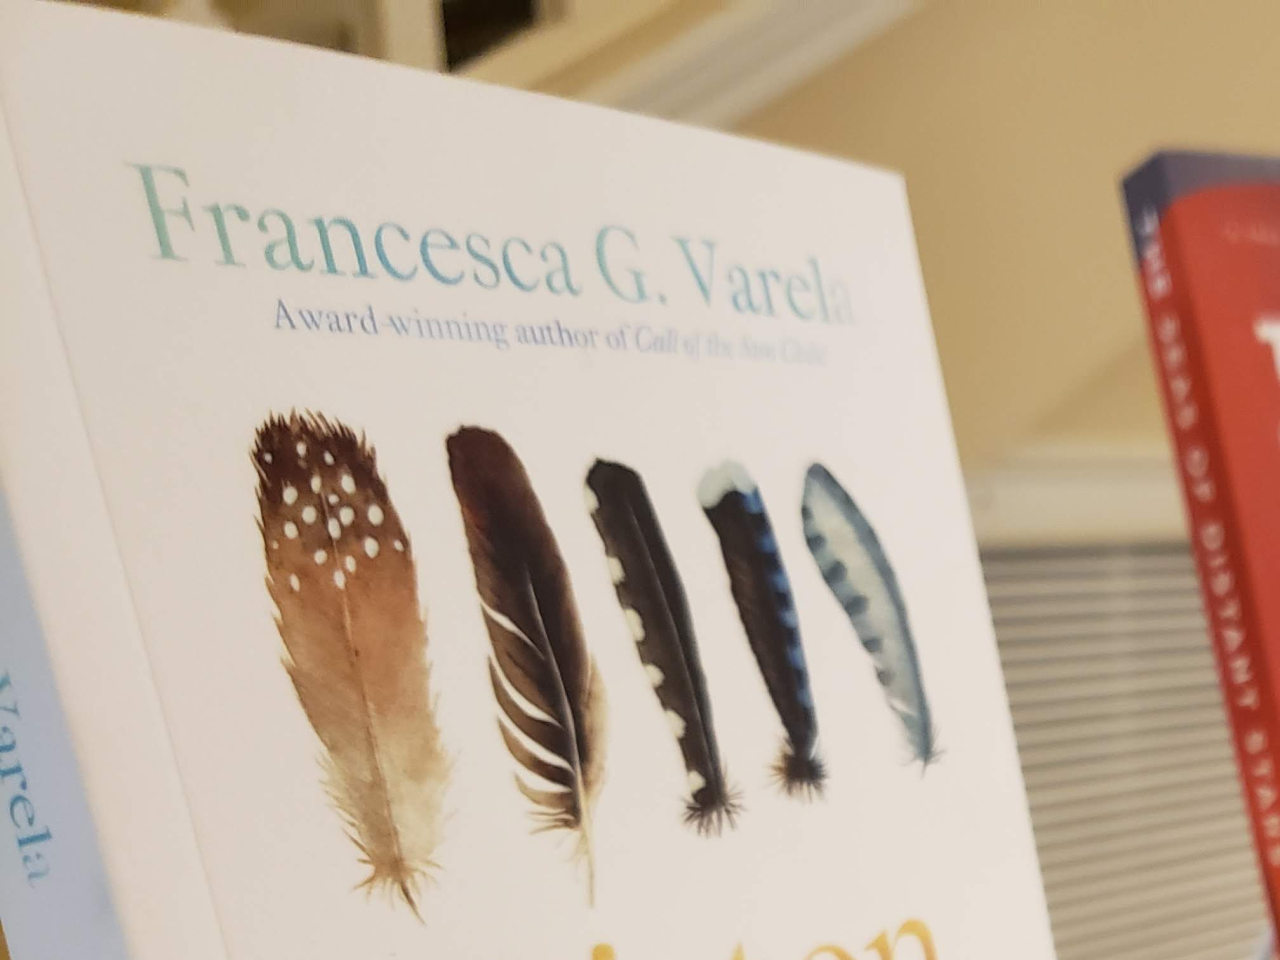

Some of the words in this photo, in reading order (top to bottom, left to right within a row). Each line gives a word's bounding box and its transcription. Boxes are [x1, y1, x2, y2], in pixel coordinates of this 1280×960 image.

[123, 160, 582, 298] Francesca
[596, 224, 669, 307] G.
[674, 233, 857, 327] Varela
[274, 297, 510, 351] Award-winning
[516, 318, 600, 351] author
[605, 324, 633, 351] of
